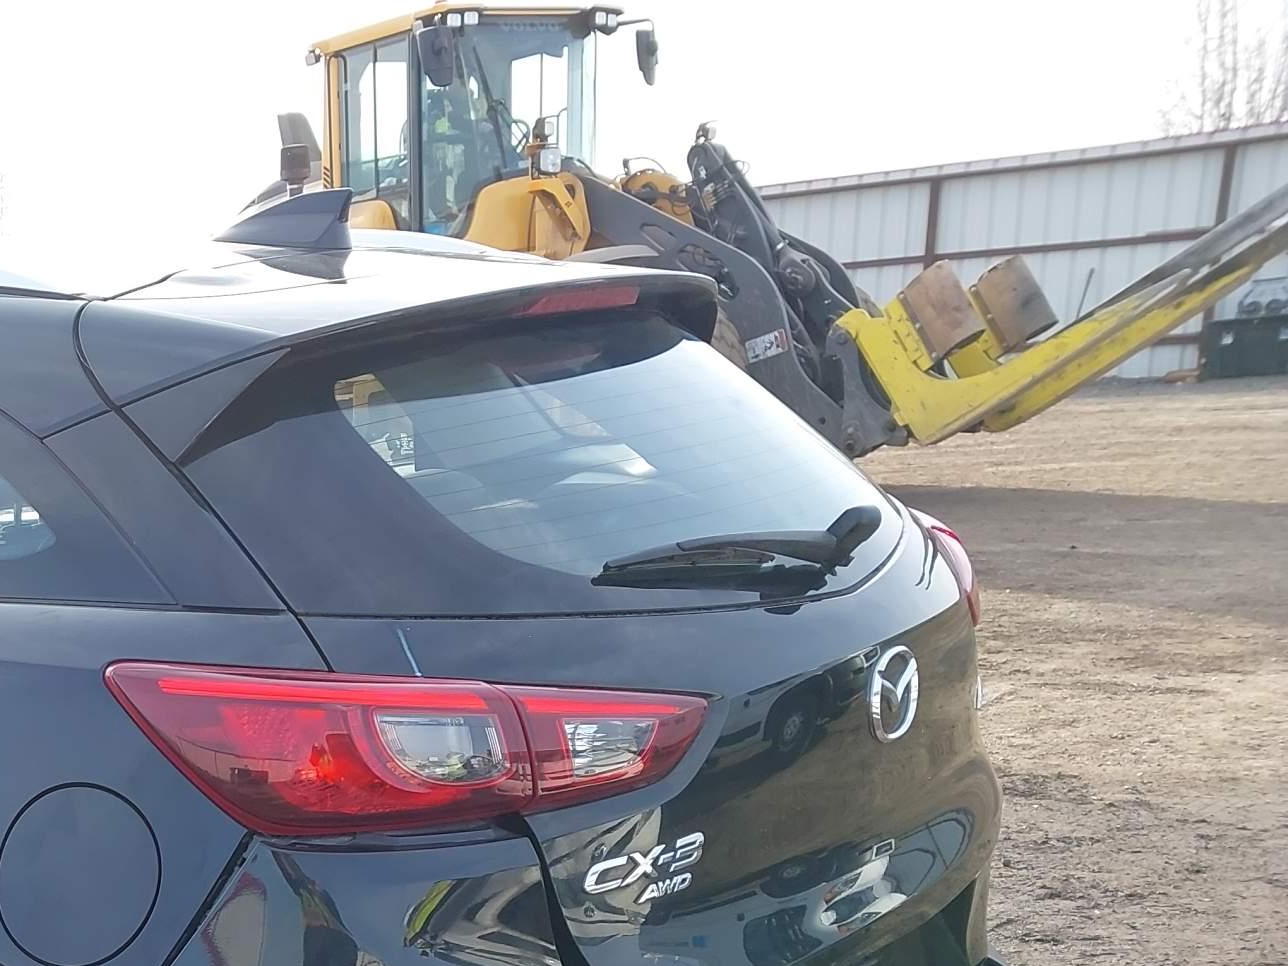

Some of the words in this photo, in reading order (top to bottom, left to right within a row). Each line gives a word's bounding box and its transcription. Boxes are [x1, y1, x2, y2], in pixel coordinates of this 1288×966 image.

[501, 21, 561, 33] VOLVO
[584, 831, 705, 895] CX-3
[634, 872, 693, 905] AWD
